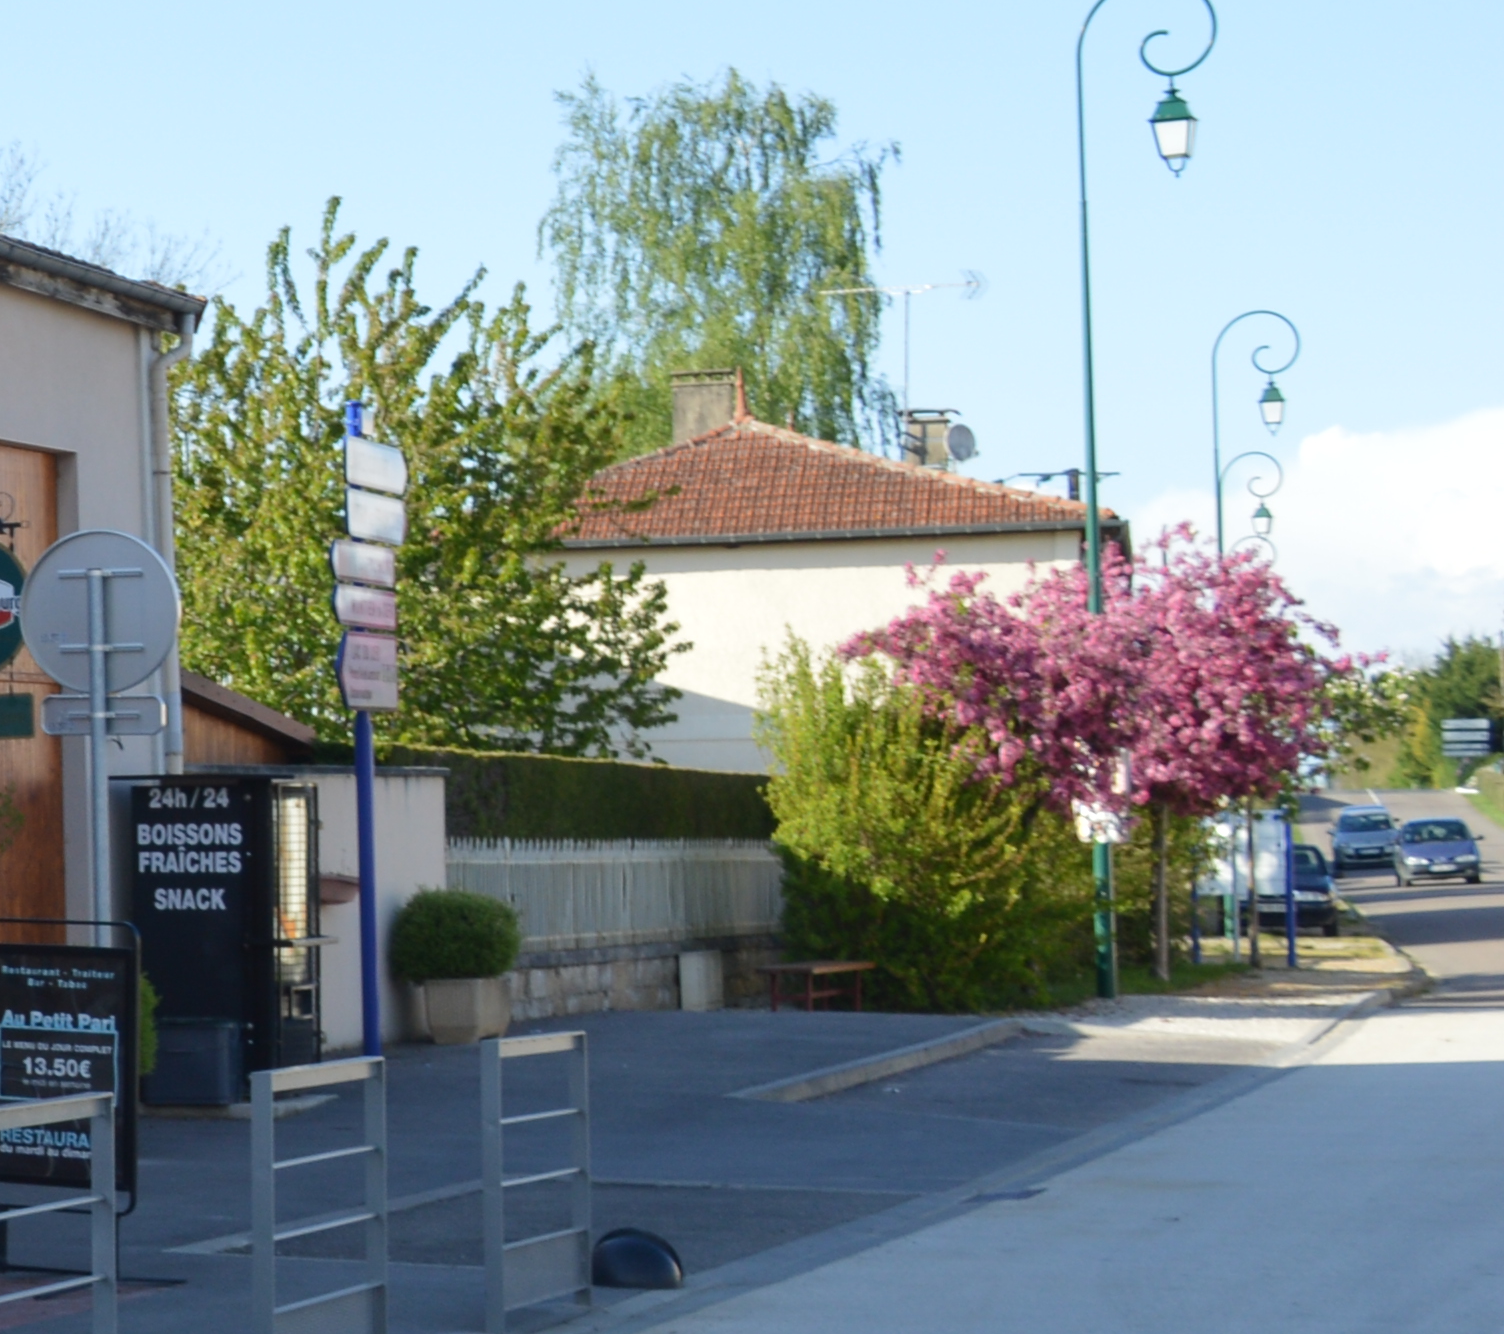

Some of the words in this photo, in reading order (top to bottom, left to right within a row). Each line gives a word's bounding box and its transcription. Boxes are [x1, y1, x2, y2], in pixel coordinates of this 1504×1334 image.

[148, 787, 188, 808] 24h
[203, 787, 230, 808] 24
[136, 823, 243, 845] BOISSONS
[138, 846, 243, 874] FRAÎCHES
[154, 888, 227, 910] SNACK
[1, 965, 61, 977] Restaurant
[72, 968, 116, 980] Traiteur
[26, 977, 46, 987] Bar
[1, 1009, 25, 1027] Au
[30, 1011, 74, 1030] Petit
[77, 1014, 116, 1032] Pari
[23, 1057, 92, 1078] 13.50€
[0, 1128, 92, 1148] RESTAURA
[0, 1142, 13, 1153] du
[15, 1144, 45, 1155] mardi
